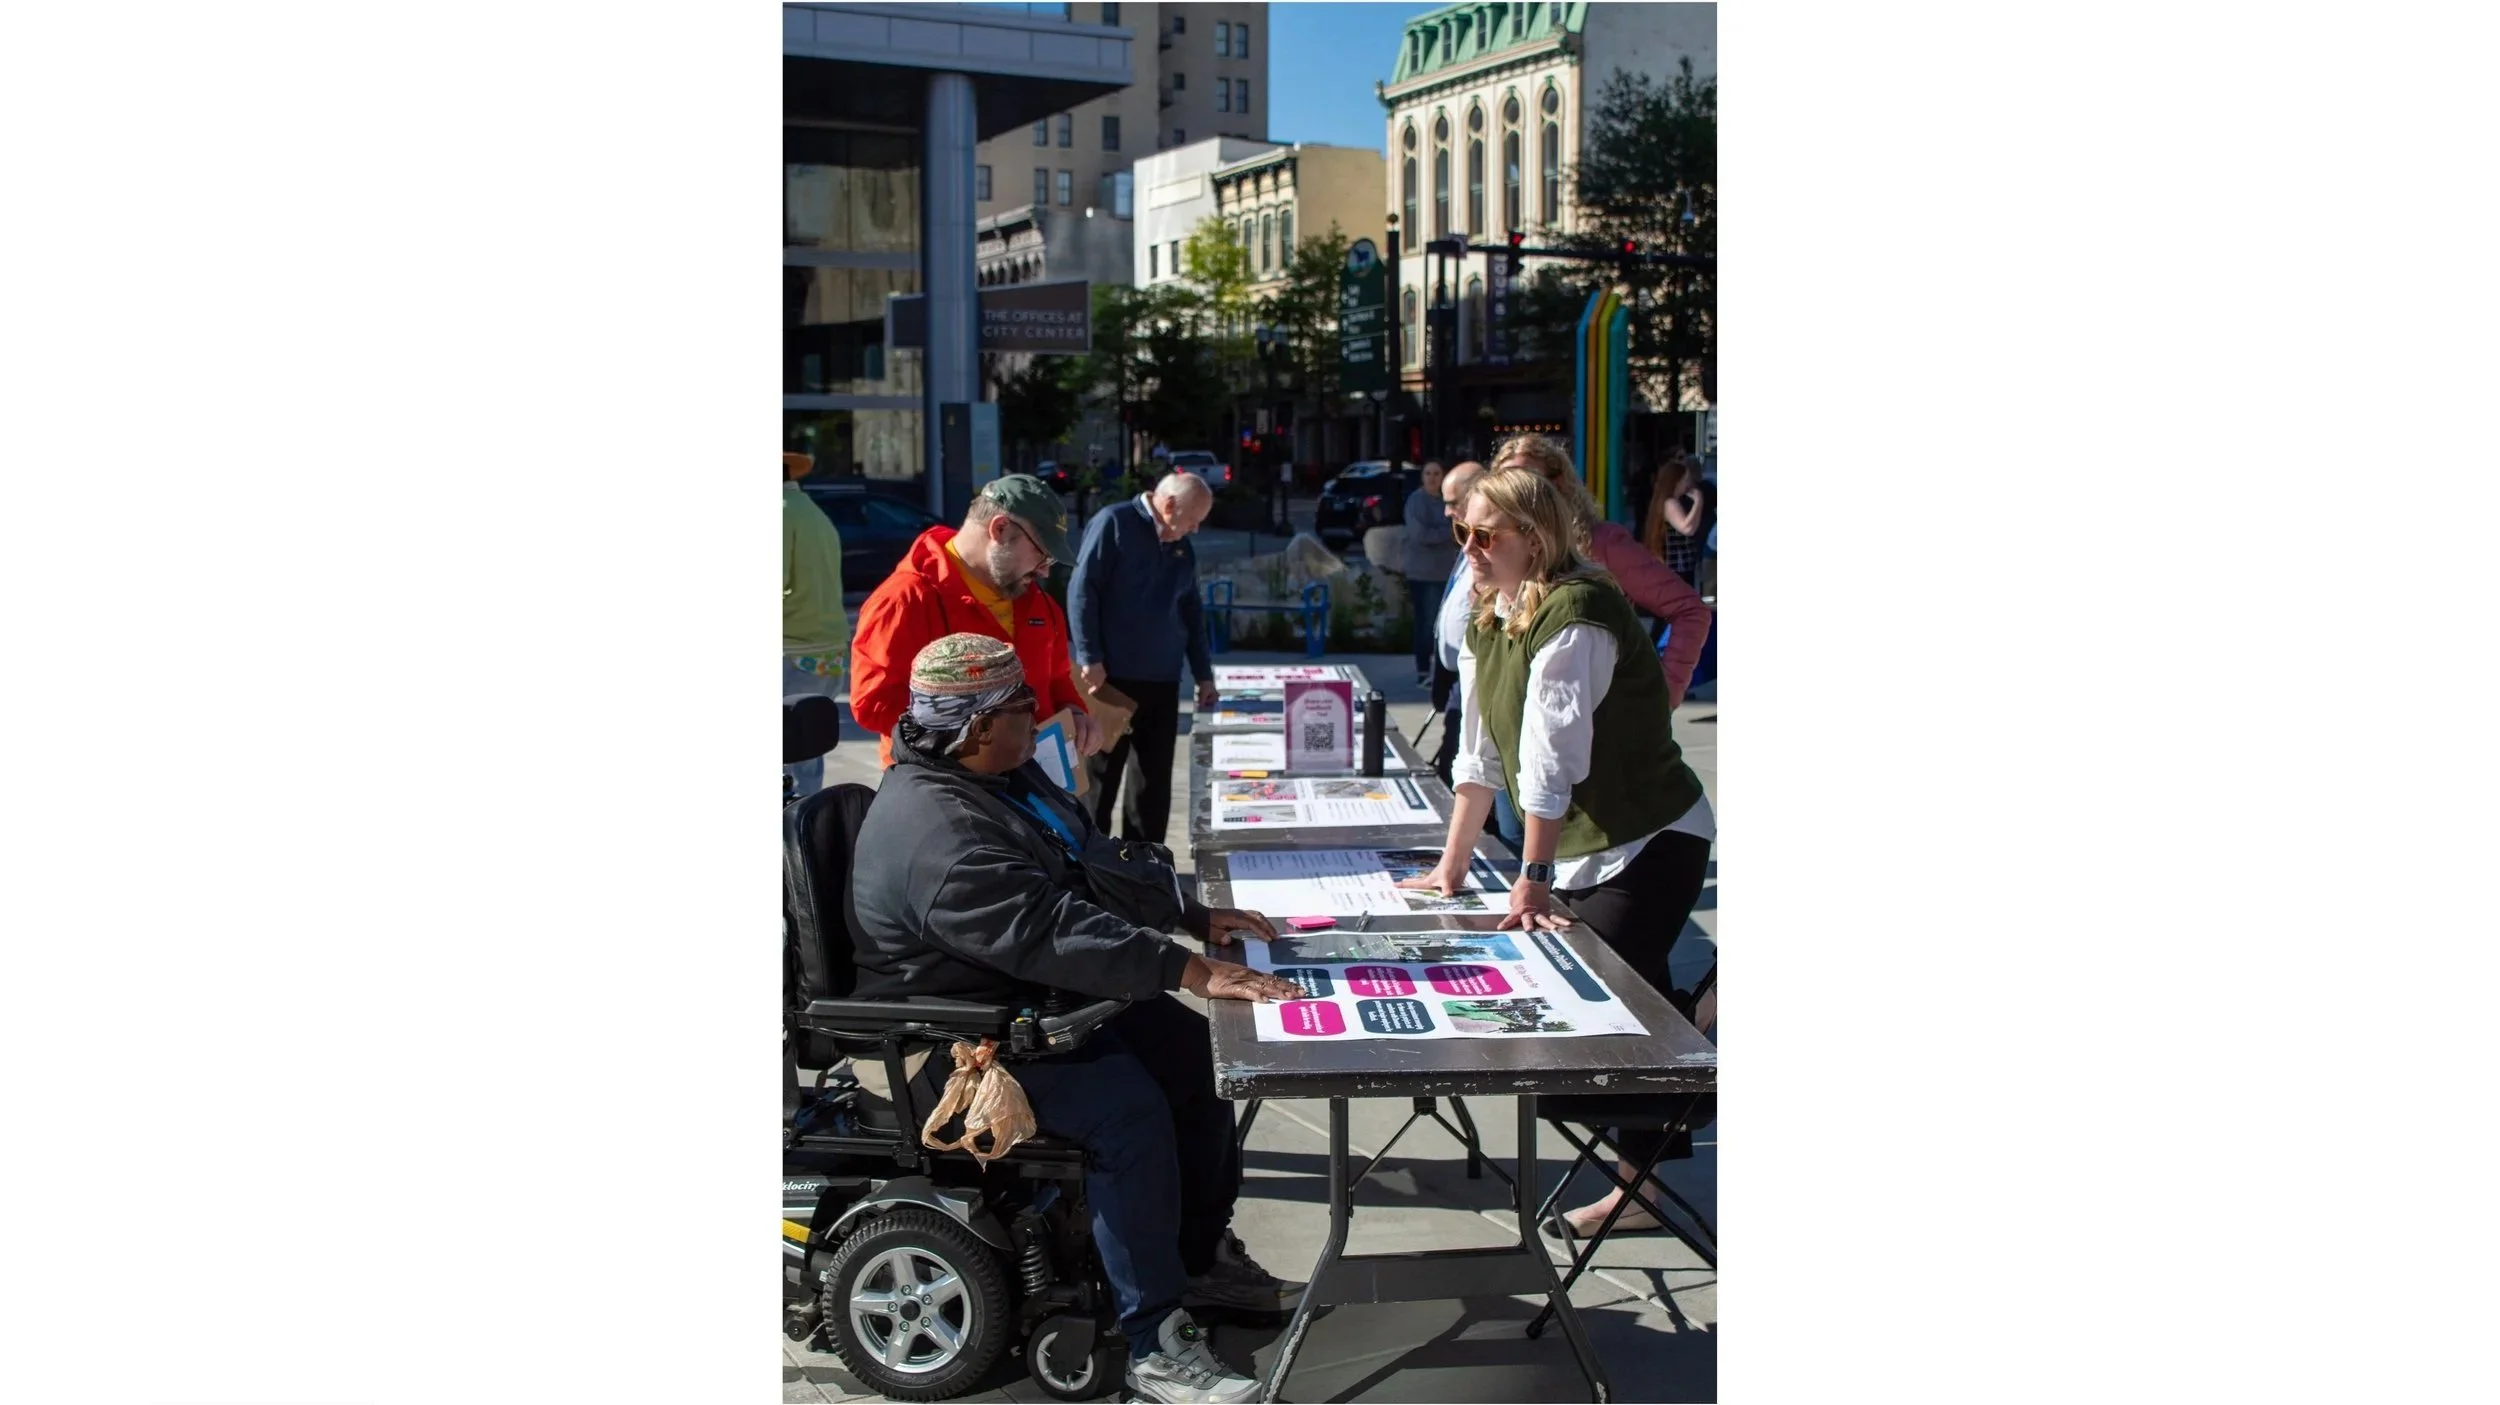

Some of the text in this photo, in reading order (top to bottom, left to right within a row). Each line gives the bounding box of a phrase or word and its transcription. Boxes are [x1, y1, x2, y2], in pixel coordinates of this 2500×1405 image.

[984, 310, 1083, 323] THE OFFICES AT
[982, 325, 1085, 338] CITY CENTER
[782, 1181, 820, 1191] elocity
